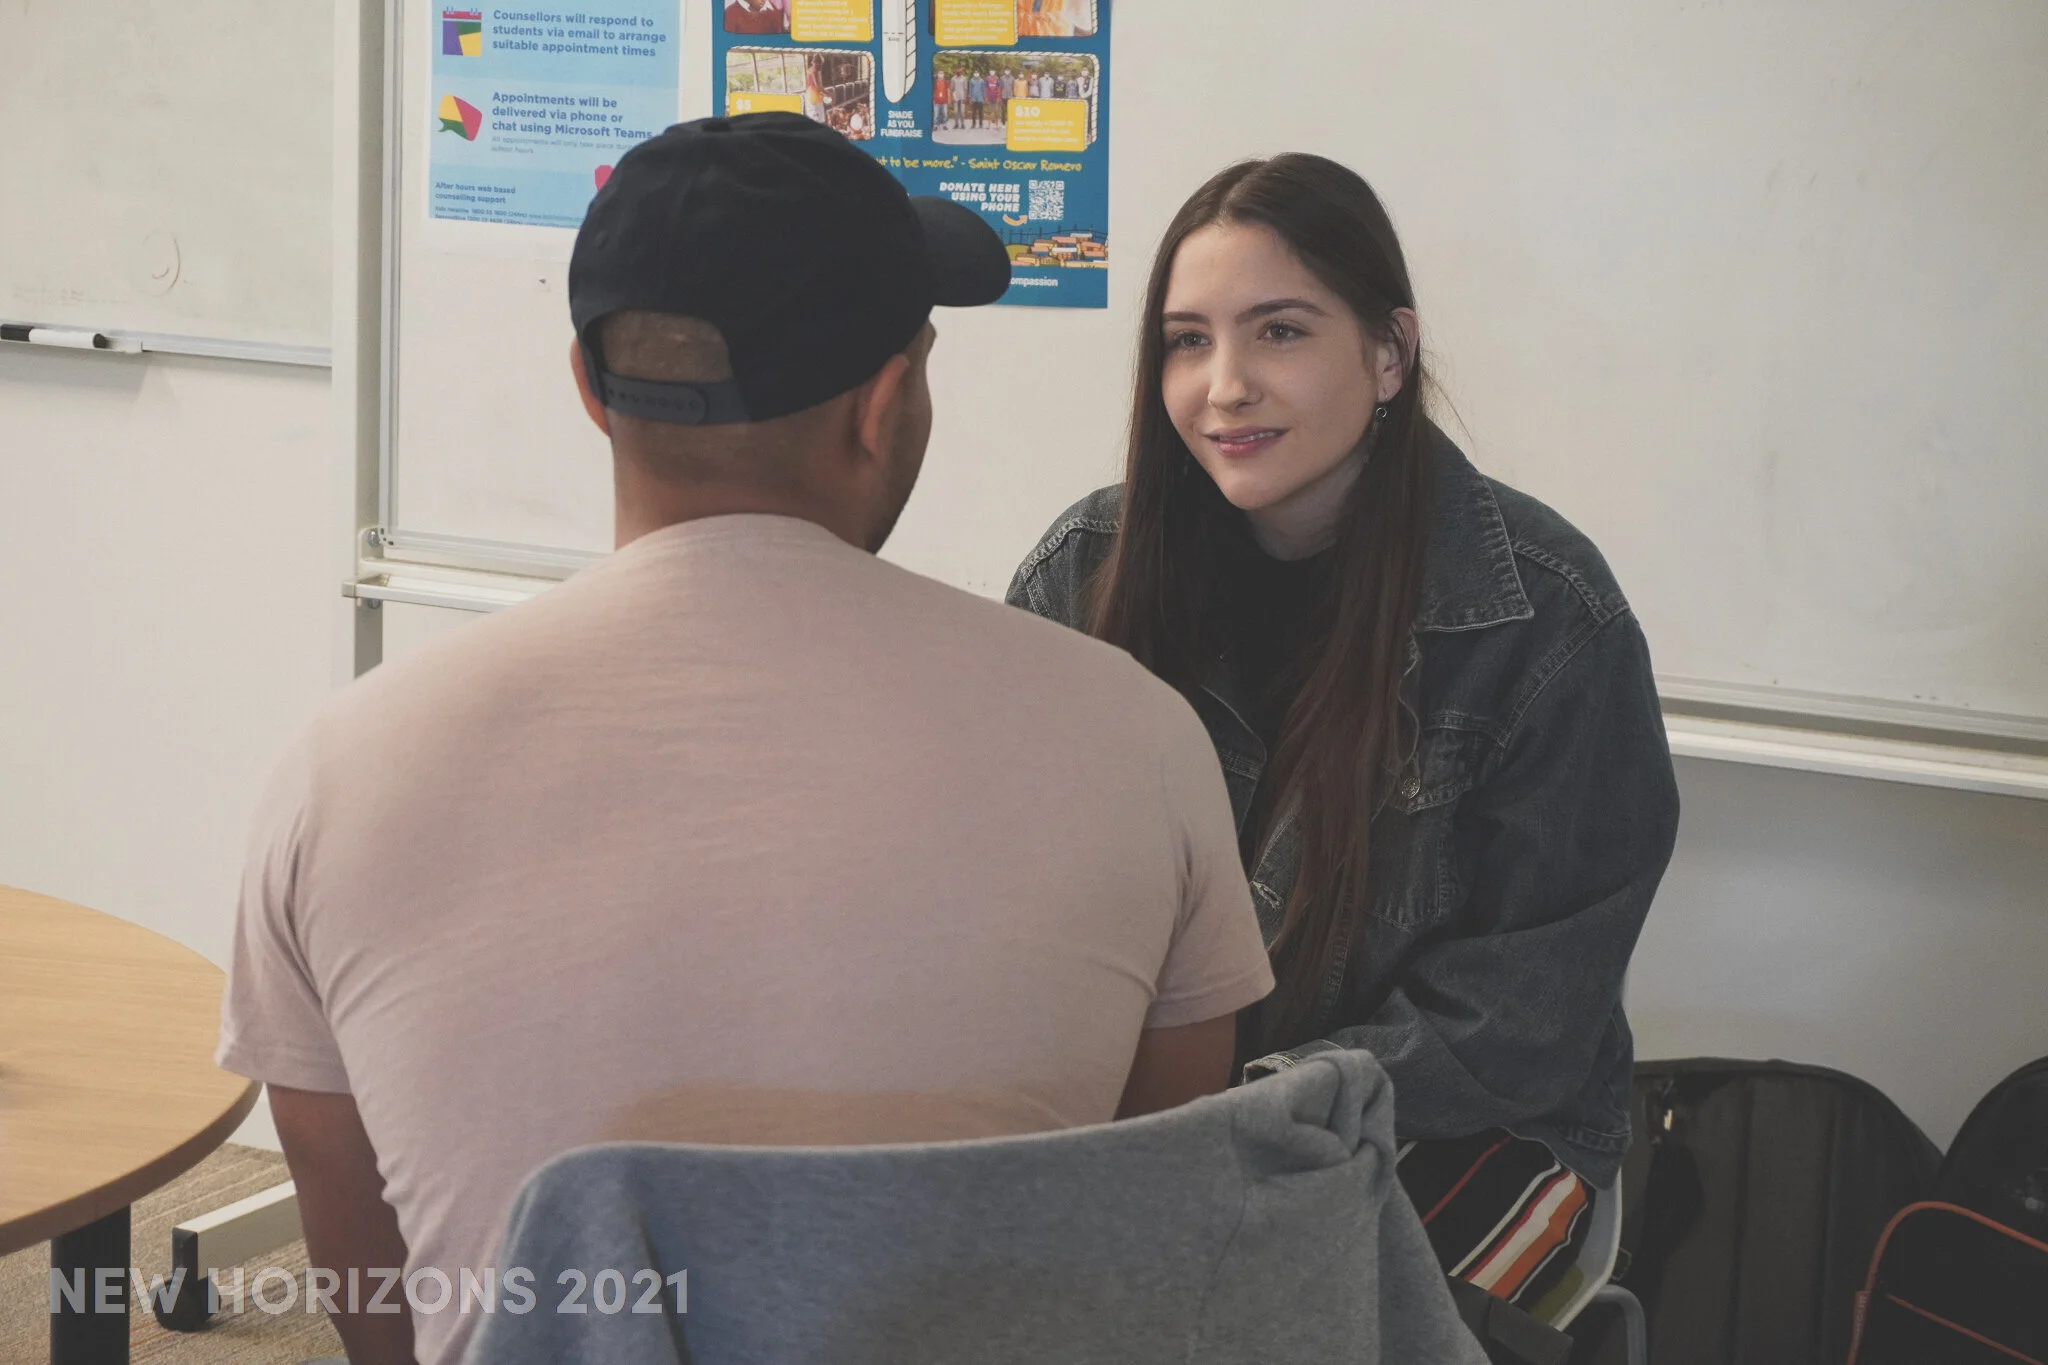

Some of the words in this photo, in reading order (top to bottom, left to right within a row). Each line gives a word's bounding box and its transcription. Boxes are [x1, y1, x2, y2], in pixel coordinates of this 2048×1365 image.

[493, 10, 562, 22] Counsellors
[565, 13, 586, 24] will
[589, 15, 637, 28] respond
[640, 17, 654, 27] to
[493, 25, 544, 36] students
[547, 27, 564, 38] via
[568, 28, 600, 40] email
[603, 30, 615, 40] to
[619, 32, 666, 44] arrange
[492, 40, 538, 51] suitable
[542, 42, 618, 55] appointment
[622, 45, 656, 56] times
[492, 92, 575, 106] Appointments
[578, 96, 600, 107] will
[603, 97, 618, 108] be
[492, 107, 546, 119] delivered
[549, 109, 567, 120] via
[570, 112, 607, 124] phone
[610, 114, 623, 123] or
[888, 110, 913, 119] SHADE
[492, 121, 517, 132] chat
[520, 123, 551, 136] using
[555, 125, 610, 138] Microsoft
[613, 128, 653, 139] Teams
[887, 120, 897, 128] AS
[897, 120, 914, 128] YOU
[880, 128, 923, 138] FUNDRAISE
[902, 157, 919, 168] be
[968, 158, 1000, 170] Saint
[1002, 160, 1036, 171] Oscar
[1040, 160, 1082, 172] Romero
[436, 182, 454, 190] After
[456, 183, 476, 192] hours
[494, 186, 516, 194] based
[939, 182, 985, 192] DONATE
[989, 183, 1020, 194] HERE
[436, 193, 476, 202] counselling
[477, 196, 506, 204] support
[951, 192, 987, 202] USING
[990, 193, 1020, 202] YOUR
[981, 202, 1020, 212] PHONE
[1010, 277, 1058, 287] ompassion
